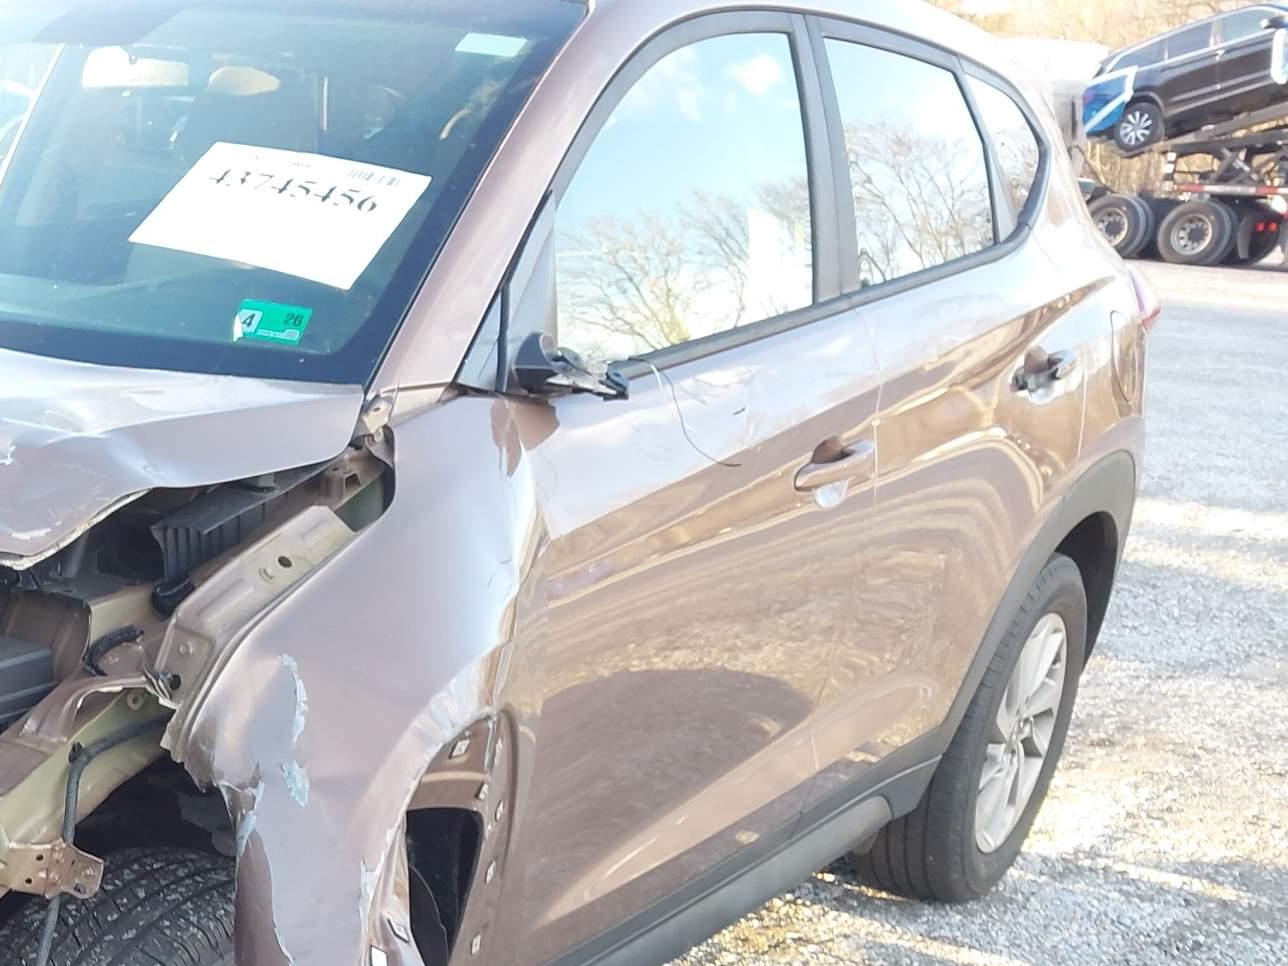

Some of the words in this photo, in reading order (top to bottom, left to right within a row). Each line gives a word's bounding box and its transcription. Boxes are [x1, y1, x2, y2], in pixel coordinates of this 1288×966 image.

[209, 168, 378, 213] 43745456
[242, 313, 257, 327] 4
[283, 312, 305, 328] 26
